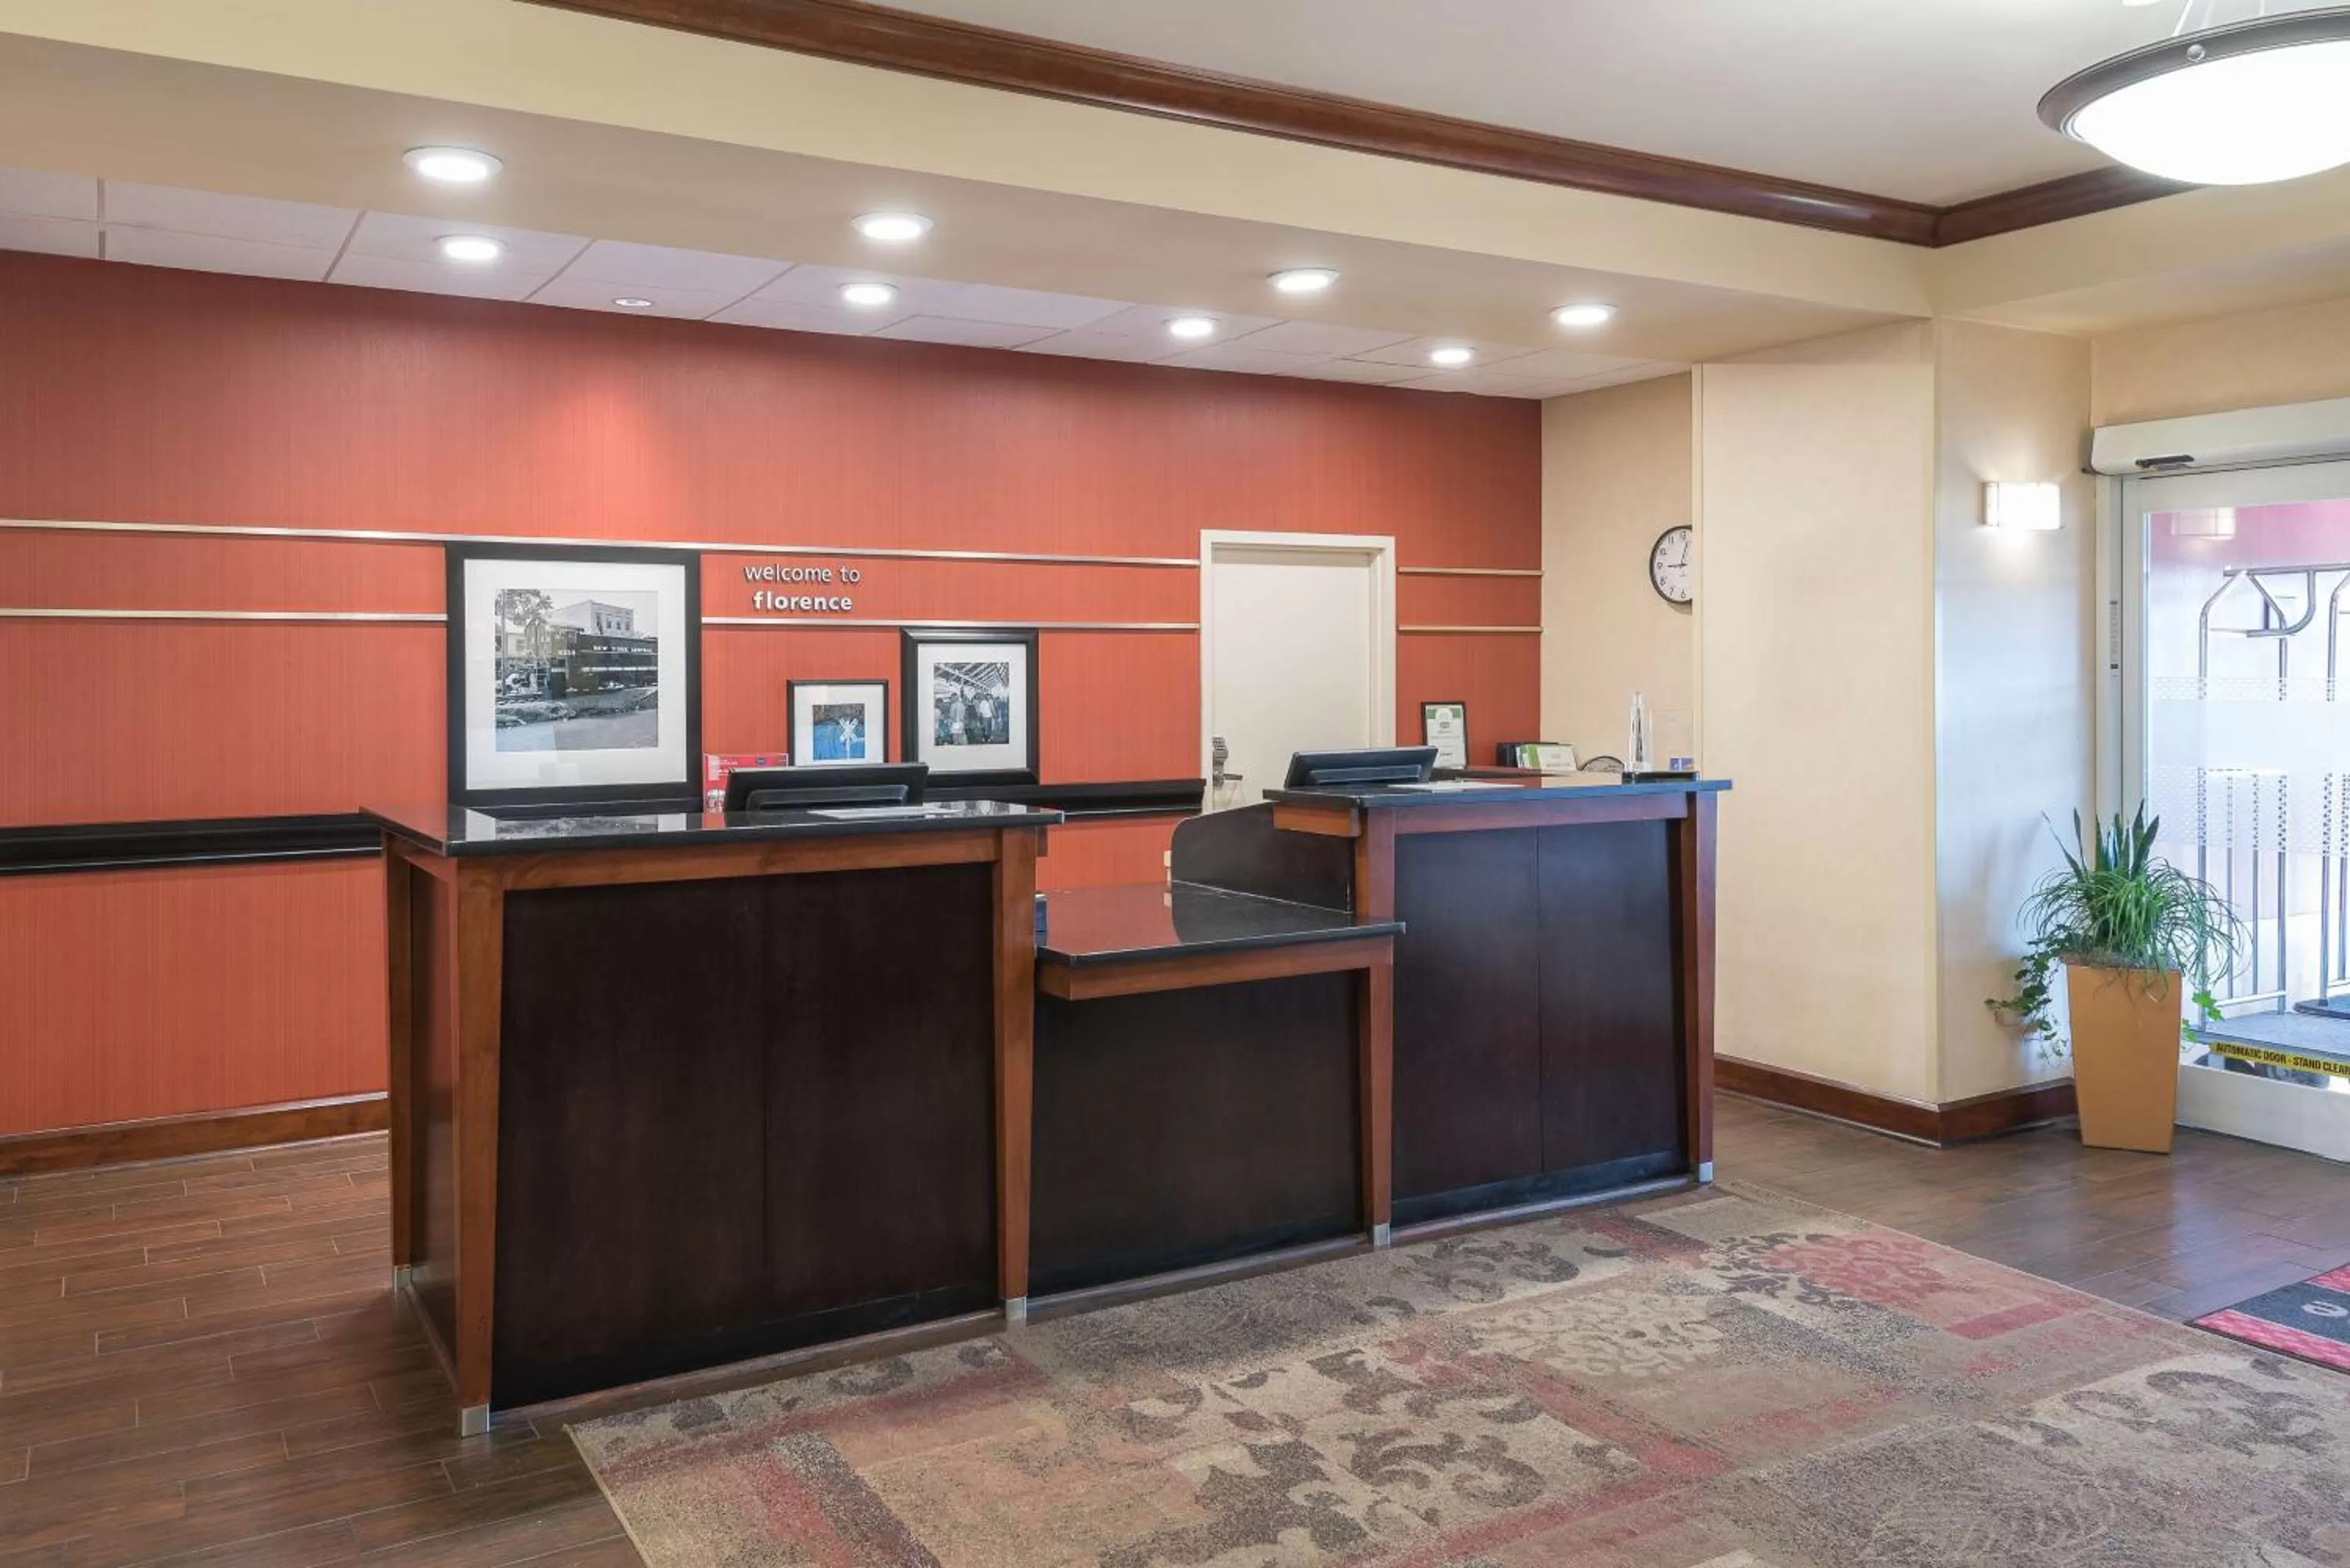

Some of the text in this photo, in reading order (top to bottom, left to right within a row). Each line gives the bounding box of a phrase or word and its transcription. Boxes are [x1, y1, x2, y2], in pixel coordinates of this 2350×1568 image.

[1668, 536, 1674, 544] 11
[744, 563, 861, 582] welcome to
[753, 591, 853, 609] florence
[2216, 1042, 2261, 1058] AUTOMATIC
[2264, 1052, 2287, 1064] DOOR
[2294, 1057, 2321, 1070] STAND
